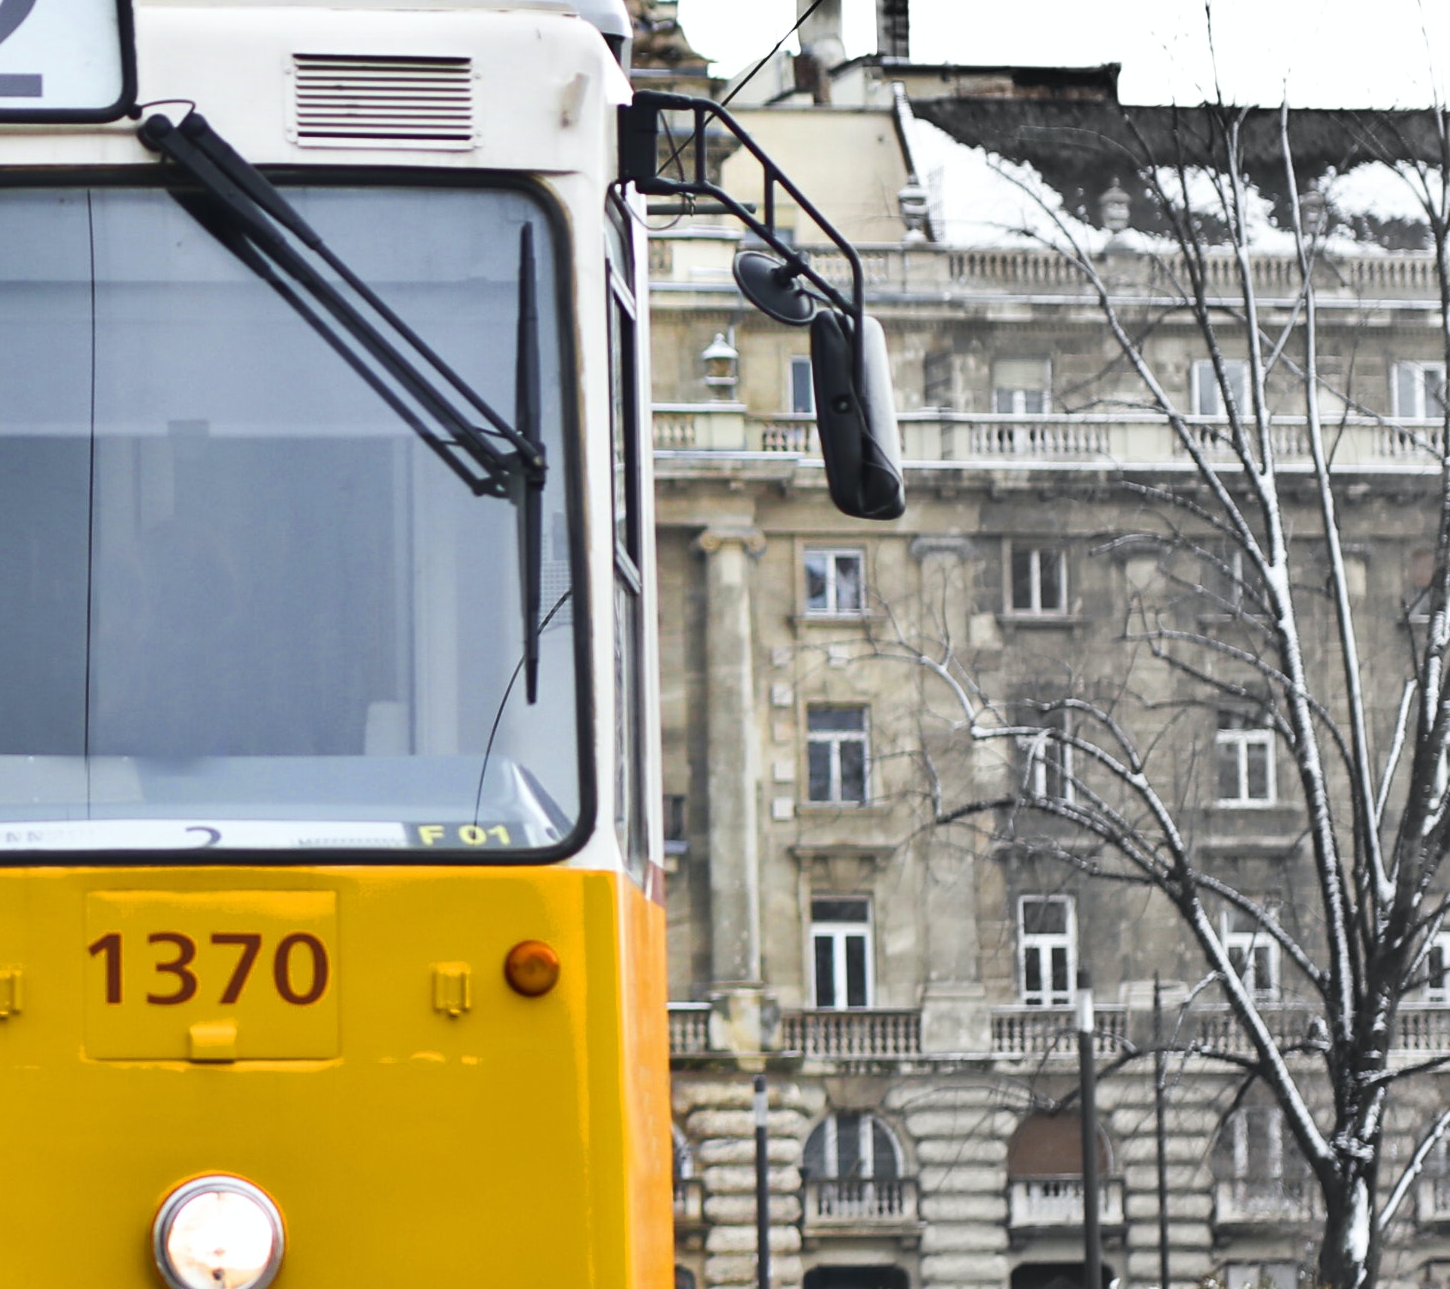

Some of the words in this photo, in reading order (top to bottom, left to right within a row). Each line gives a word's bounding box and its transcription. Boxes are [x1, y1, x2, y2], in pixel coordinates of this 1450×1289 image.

[417, 824, 445, 847] F
[458, 824, 511, 847] 01
[88, 932, 330, 1006] 1370
